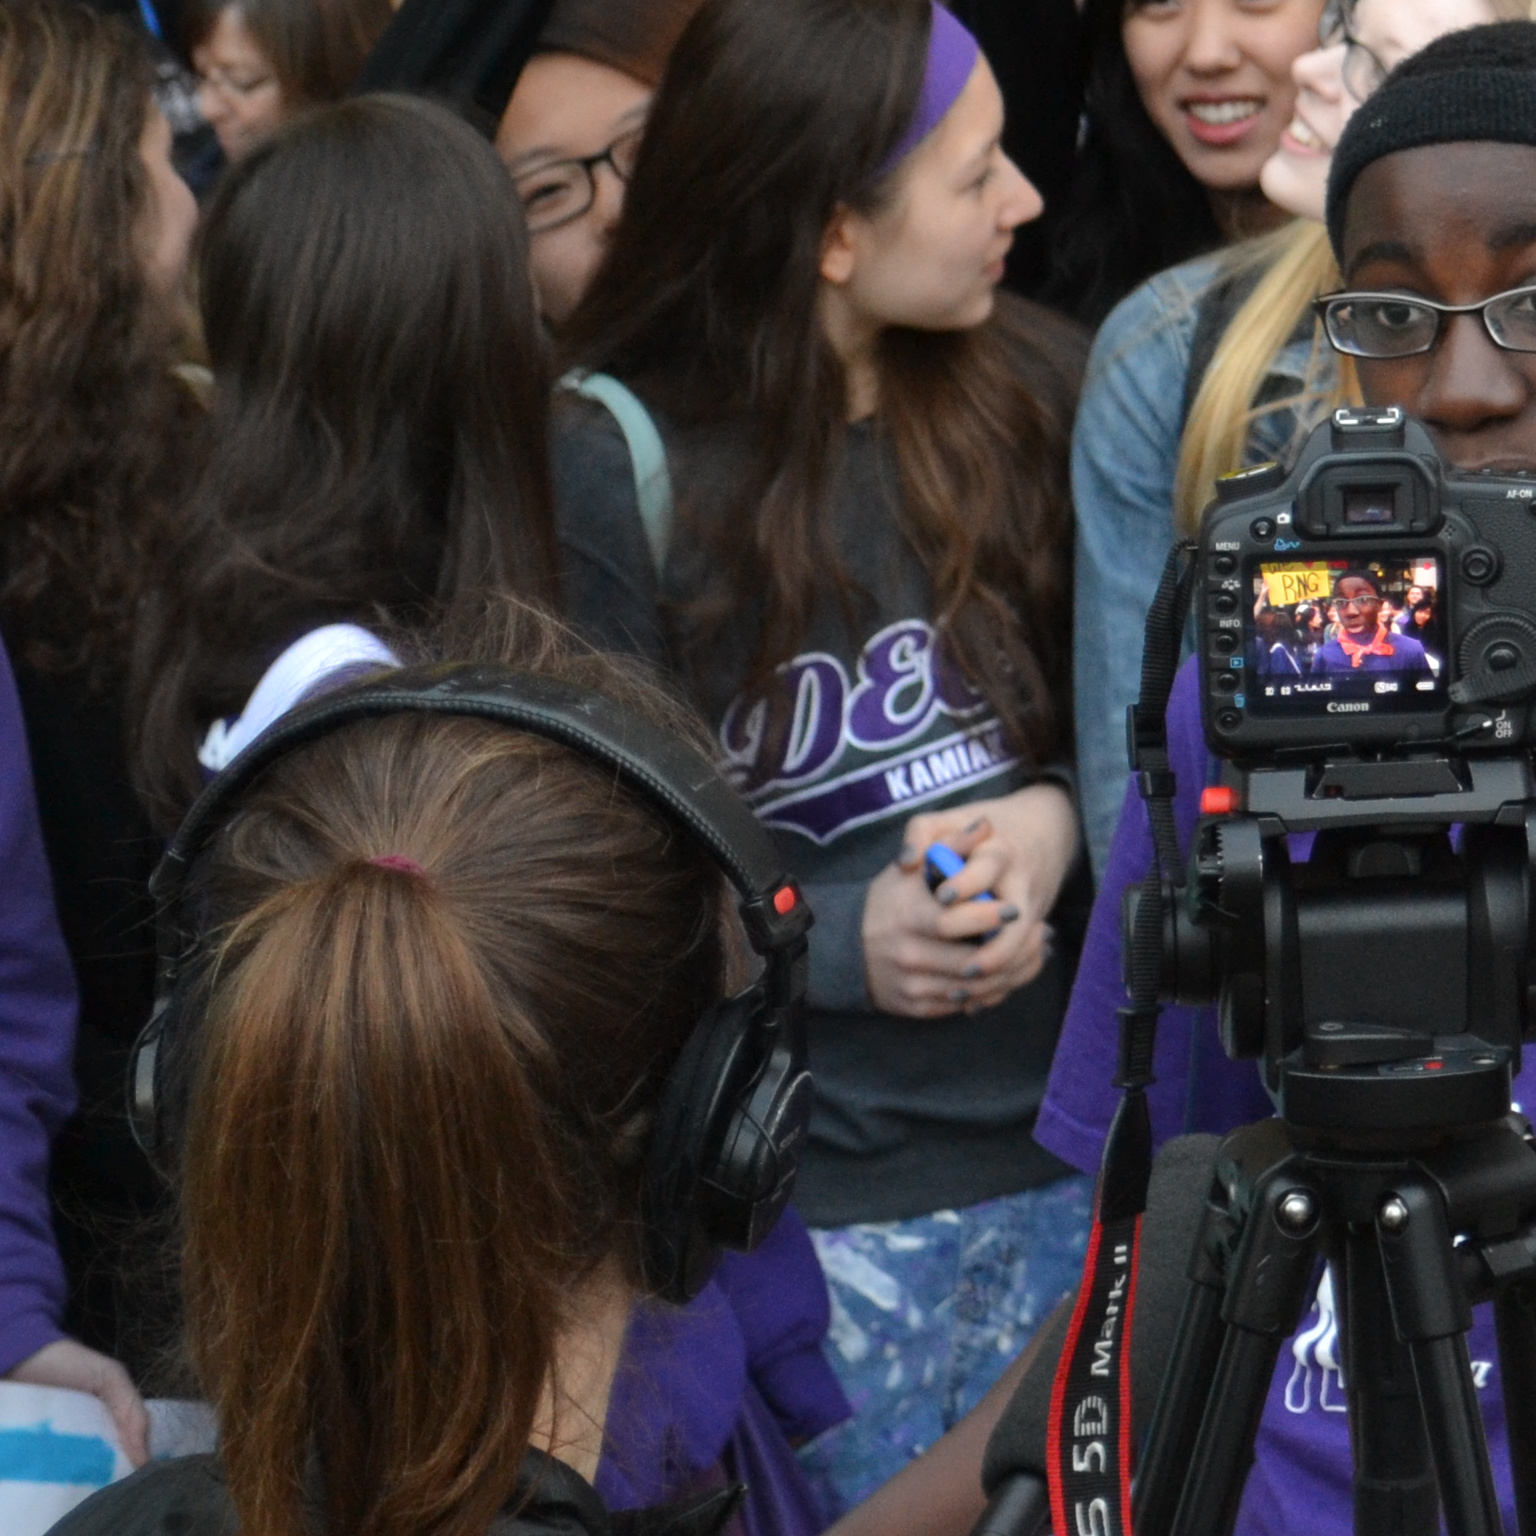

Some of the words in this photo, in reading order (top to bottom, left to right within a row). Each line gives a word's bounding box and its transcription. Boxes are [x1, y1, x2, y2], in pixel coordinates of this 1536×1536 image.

[1506, 489, 1533, 499] AF-ON
[1215, 541, 1240, 551] MENU
[1326, 700, 1370, 713] Canon
[1495, 721, 1511, 729] ON
[1495, 728, 1513, 738] OFF
[1073, 1396, 1107, 1473] 5D
[1090, 1273, 1127, 1377] Mark
